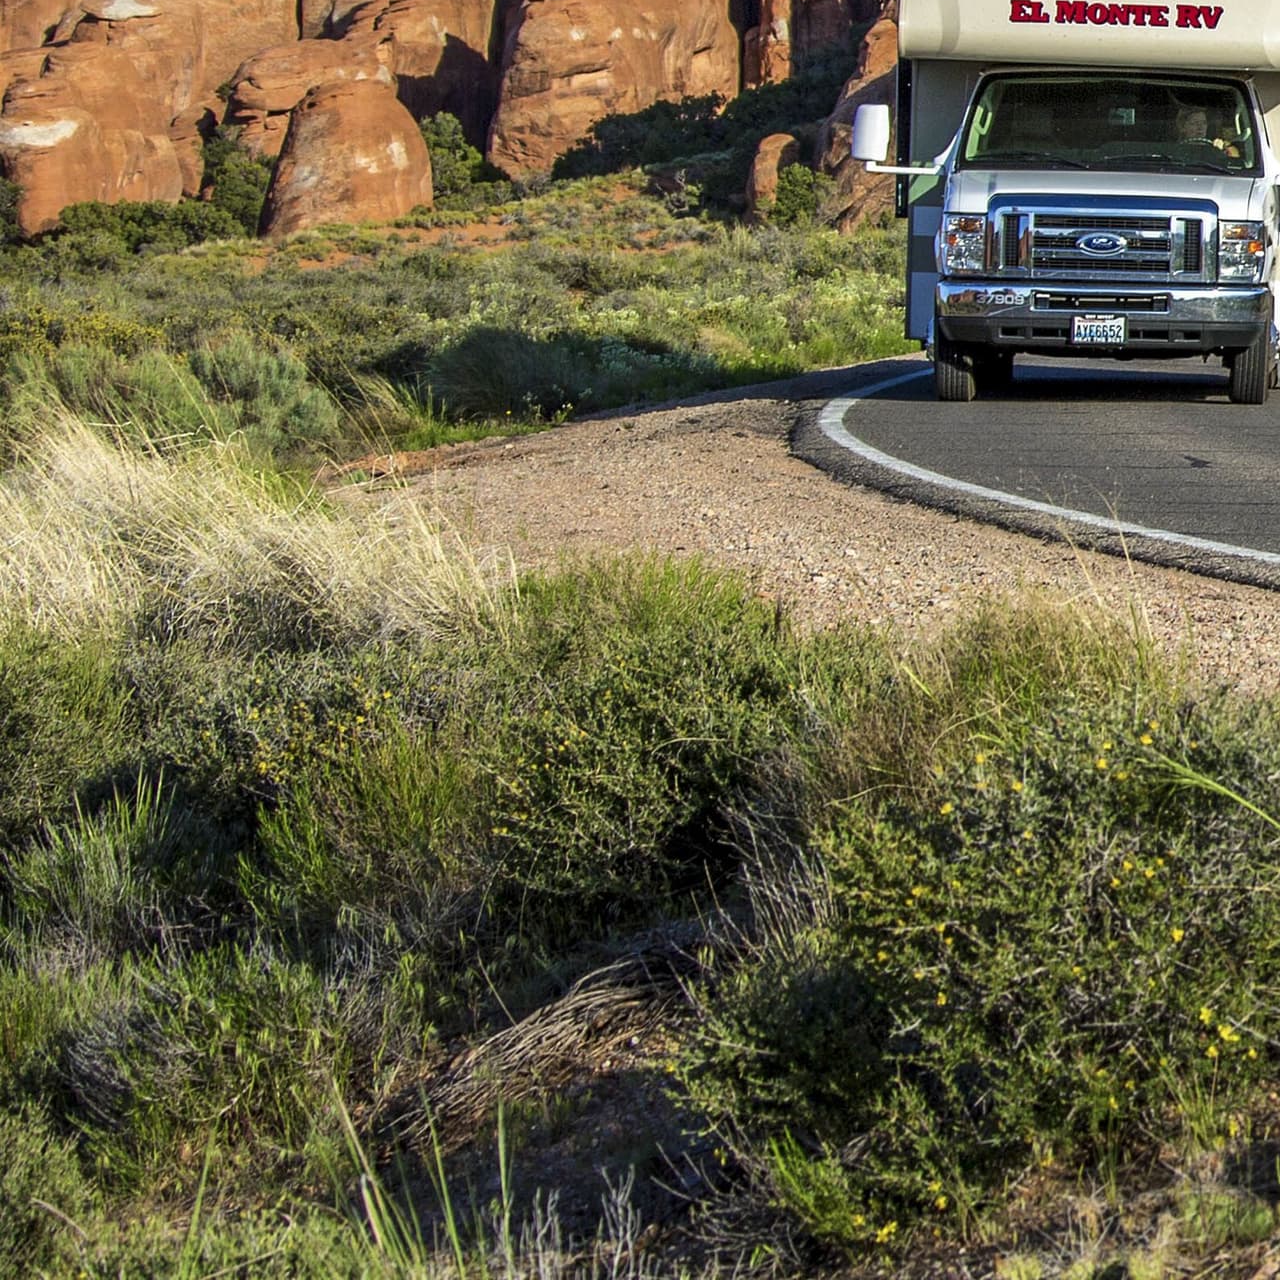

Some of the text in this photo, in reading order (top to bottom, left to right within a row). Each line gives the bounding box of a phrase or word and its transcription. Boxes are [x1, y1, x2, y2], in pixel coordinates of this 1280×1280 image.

[1009, 0, 1224, 29] EL MONTE RV
[976, 293, 1025, 305] 37909
